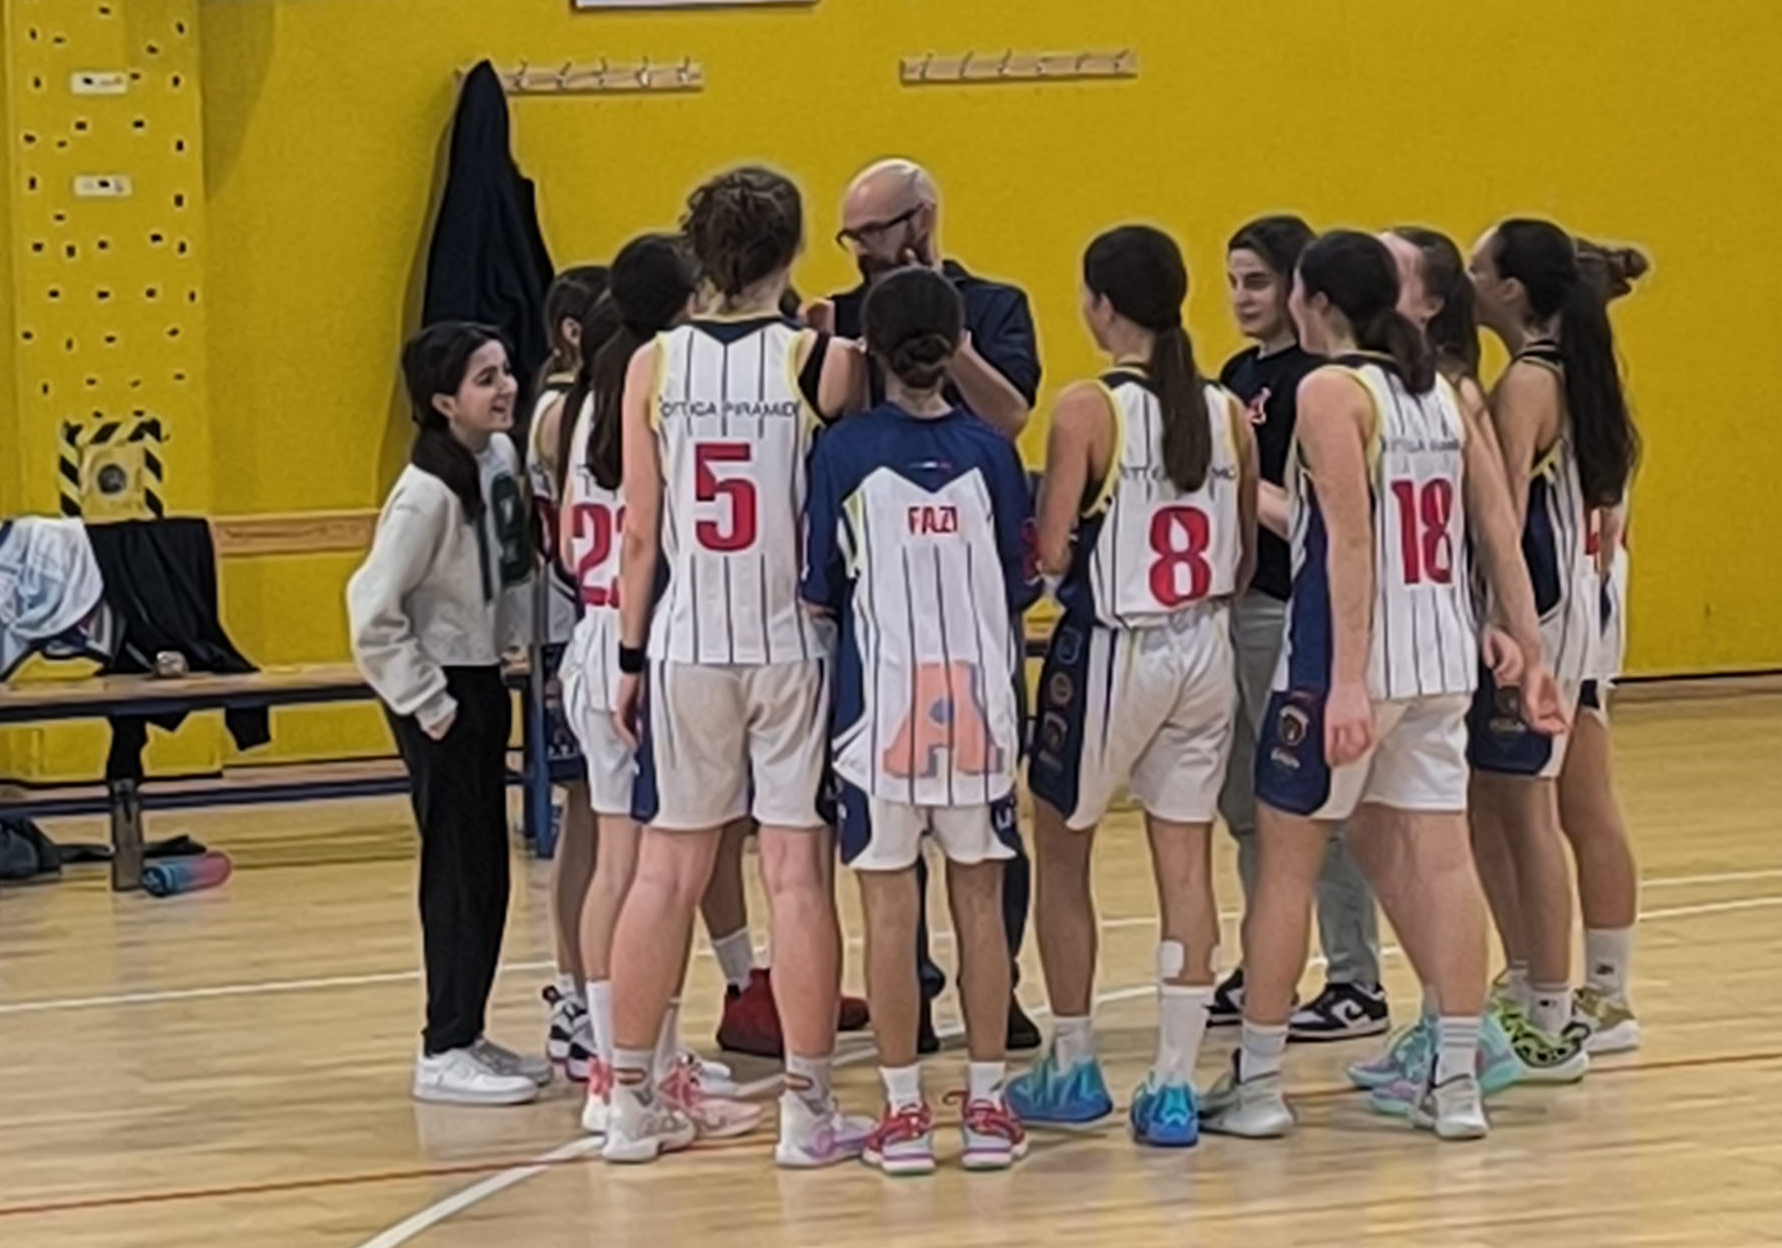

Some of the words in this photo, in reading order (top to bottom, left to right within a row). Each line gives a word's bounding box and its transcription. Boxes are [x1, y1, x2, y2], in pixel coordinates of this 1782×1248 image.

[695, 442, 757, 552] 5
[907, 505, 958, 535] FAZI
[1390, 477, 1453, 586] 18
[1148, 505, 1212, 607] 8
